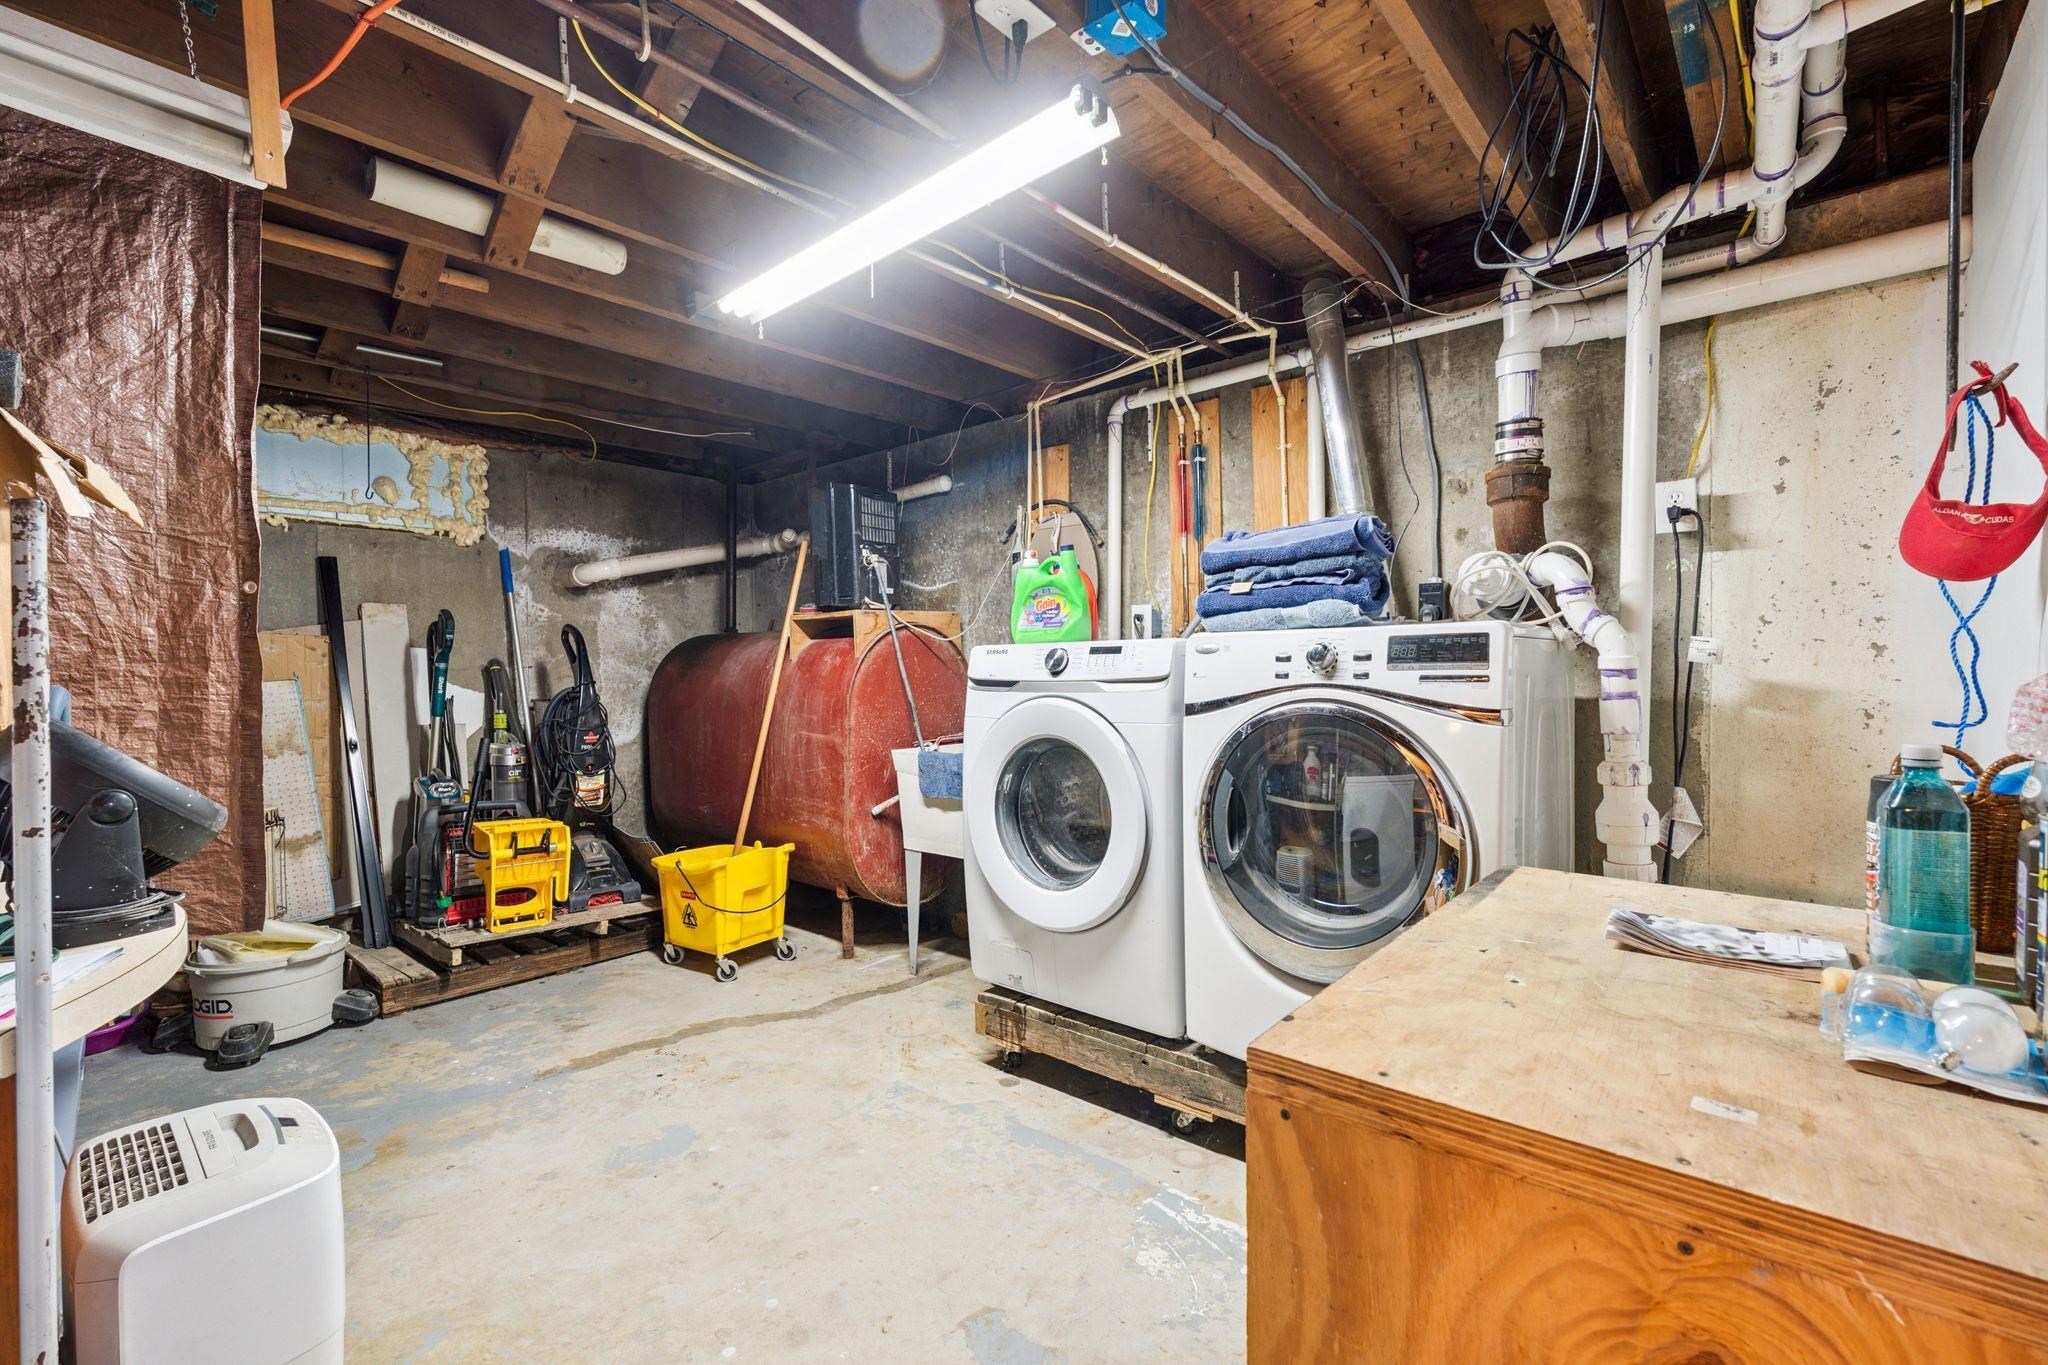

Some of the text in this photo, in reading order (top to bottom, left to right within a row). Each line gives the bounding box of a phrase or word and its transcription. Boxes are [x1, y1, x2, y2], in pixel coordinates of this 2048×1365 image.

[1931, 507, 2015, 524] ALDAN CUDAS
[1035, 598, 1057, 612] Gain
[194, 999, 233, 1014] DGID
